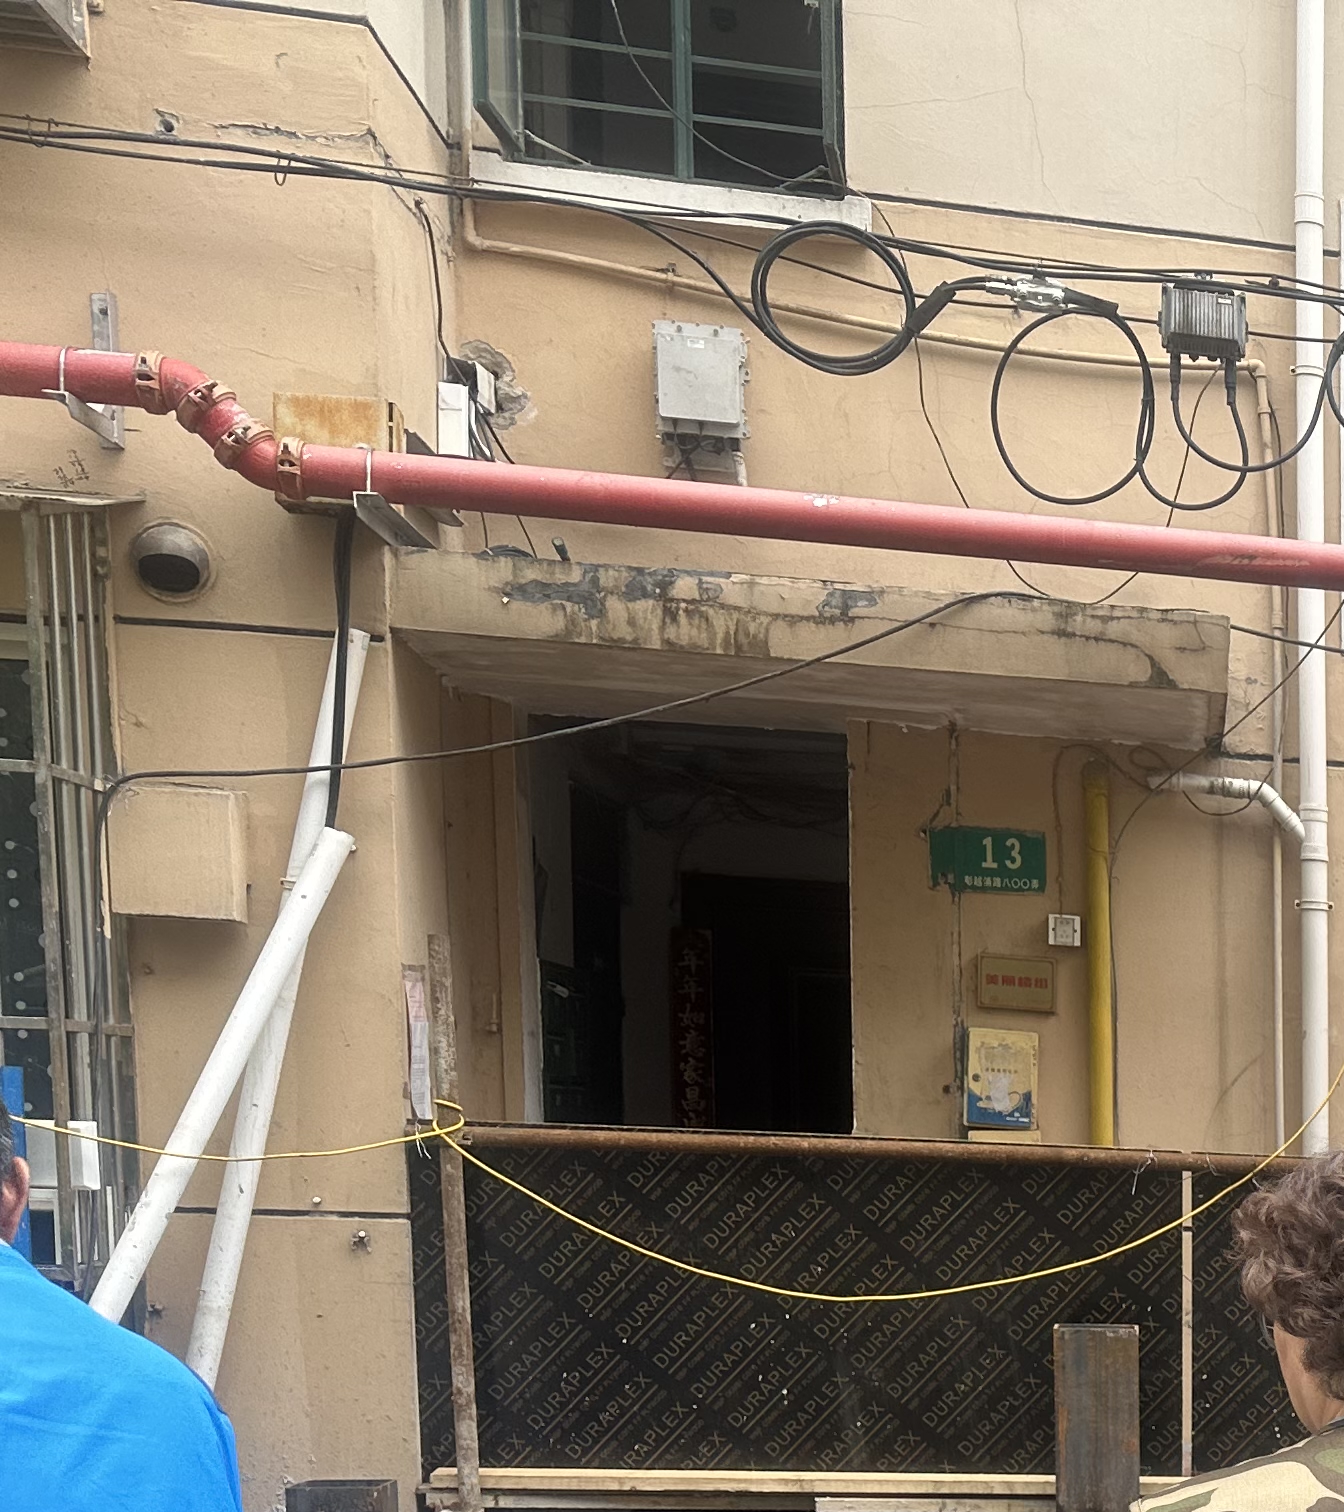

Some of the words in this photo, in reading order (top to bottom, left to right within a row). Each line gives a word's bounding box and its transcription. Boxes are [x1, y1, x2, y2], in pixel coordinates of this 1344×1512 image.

[982, 836, 1022, 869] 13
[664, 1153, 731, 1219] DURAPL
[703, 1162, 789, 1250] DURAPLEX
[900, 1168, 984, 1251] DURAPLEX
[1092, 1172, 1176, 1254] DURAPLEX
[538, 1190, 626, 1279] DURALEX
[576, 1221, 665, 1310] DURAPEX
[740, 1192, 826, 1279] DURAPLEX
[934, 1197, 1021, 1282] DURAPLEX
[473, 1281, 538, 1348] RAPLEX
[652, 1282, 739, 1370] DURAPLEX
[813, 1253, 899, 1340] DURPLEX
[851, 1283, 931, 1370] DURAPLE
[1007, 1258, 1094, 1342] DURAPLE
[487, 1311, 577, 1401] DURAPLEX
[526, 1341, 615, 1430] DURAPLEX
[690, 1312, 777, 1399] DURAPLEX
[727, 1341, 814, 1429] DURAPLEX
[885, 1313, 970, 1398] DURAPLEX
[921, 1342, 1005, 1428] DURAPLEX
[1191, 1352, 1256, 1420] URAPLEX
[565, 1371, 653, 1460] DURAPLEX
[619, 1400, 690, 1469] RAPLEX
[764, 1371, 849, 1458] DURAPLEX
[810, 1400, 886, 1471] URAPLEX
[957, 1372, 1042, 1456] DURAPLEX
